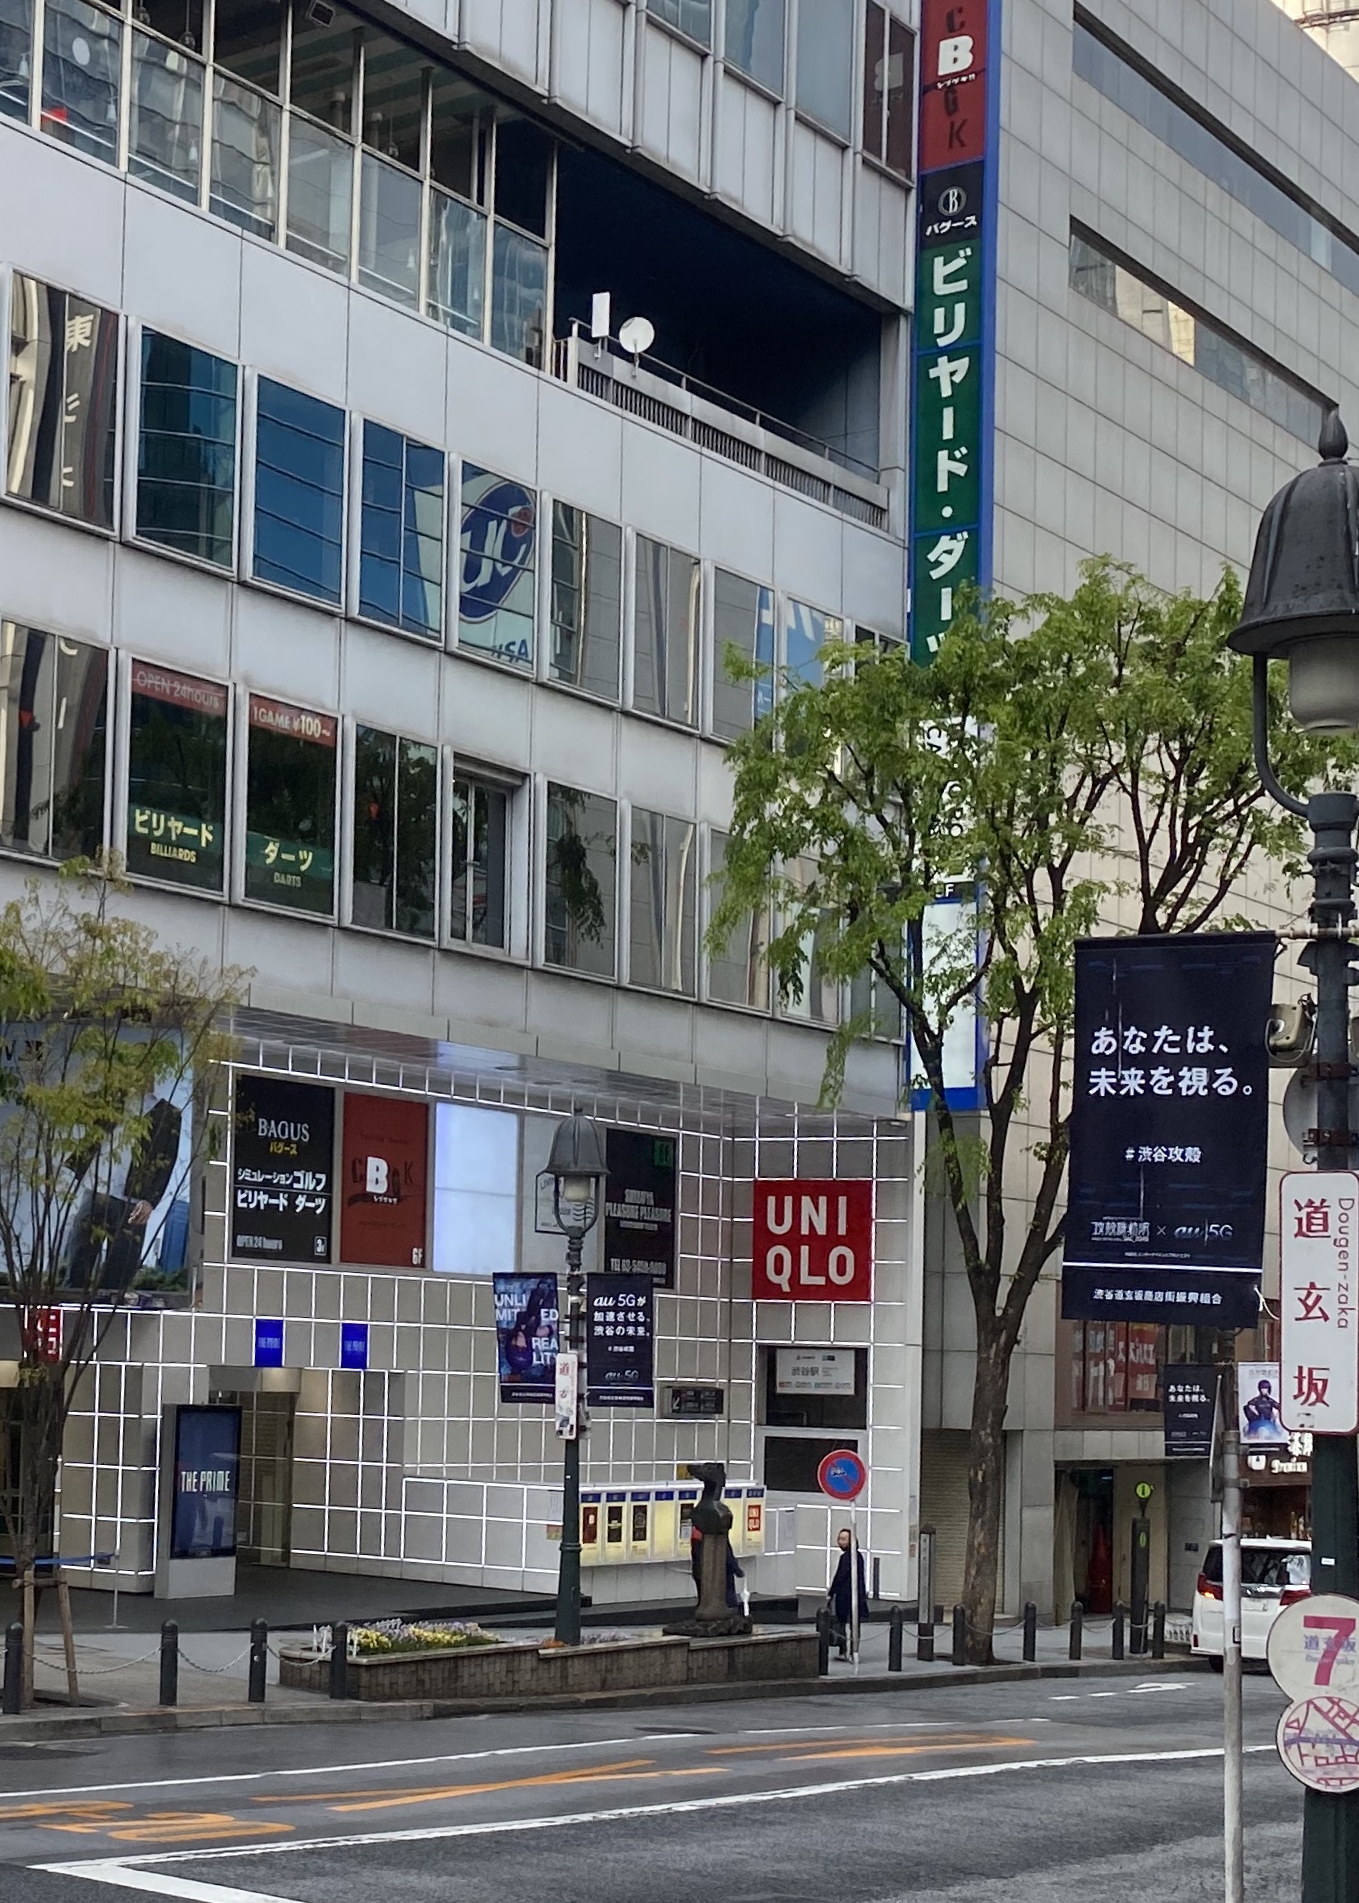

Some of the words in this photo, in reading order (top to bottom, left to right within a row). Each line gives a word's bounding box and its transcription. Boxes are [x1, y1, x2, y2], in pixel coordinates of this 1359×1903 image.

[925, 214, 978, 237] バグース
[927, 247, 973, 652] ビリヤード・ダー
[136, 670, 171, 695] OPEN
[134, 808, 215, 848] ビリヤード
[150, 841, 197, 864] BILLIARDS
[264, 840, 314, 872] ダーツ
[273, 871, 302, 888] DARTS
[1090, 1024, 1229, 1055] あなたは、
[1088, 1066, 1253, 1097] 未来を視る。
[257, 1117, 311, 1143] BAGUS
[237, 1167, 327, 1192] シミュレーションゴルフ
[236, 1188, 289, 1212] ビリヤード
[294, 1194, 326, 1215] ダーツ
[766, 1195, 848, 1236] UNI
[1209, 1224, 1234, 1242] 5G
[765, 1245, 855, 1293] QLO
[1333, 1197, 1357, 1330] Dougen-zaka
[494, 1293, 526, 1307] UNLI
[593, 1295, 616, 1307] au
[1292, 1197, 1331, 1408] 道玄坂
[495, 1308, 518, 1321] MIT
[541, 1308, 559, 1321] ED
[531, 1337, 559, 1350] REA
[791, 1366, 820, 1377] 渋谷駅
[181, 1470, 198, 1493] THE
[199, 1469, 232, 1493] PRIME
[1303, 1615, 1357, 1686] 7
